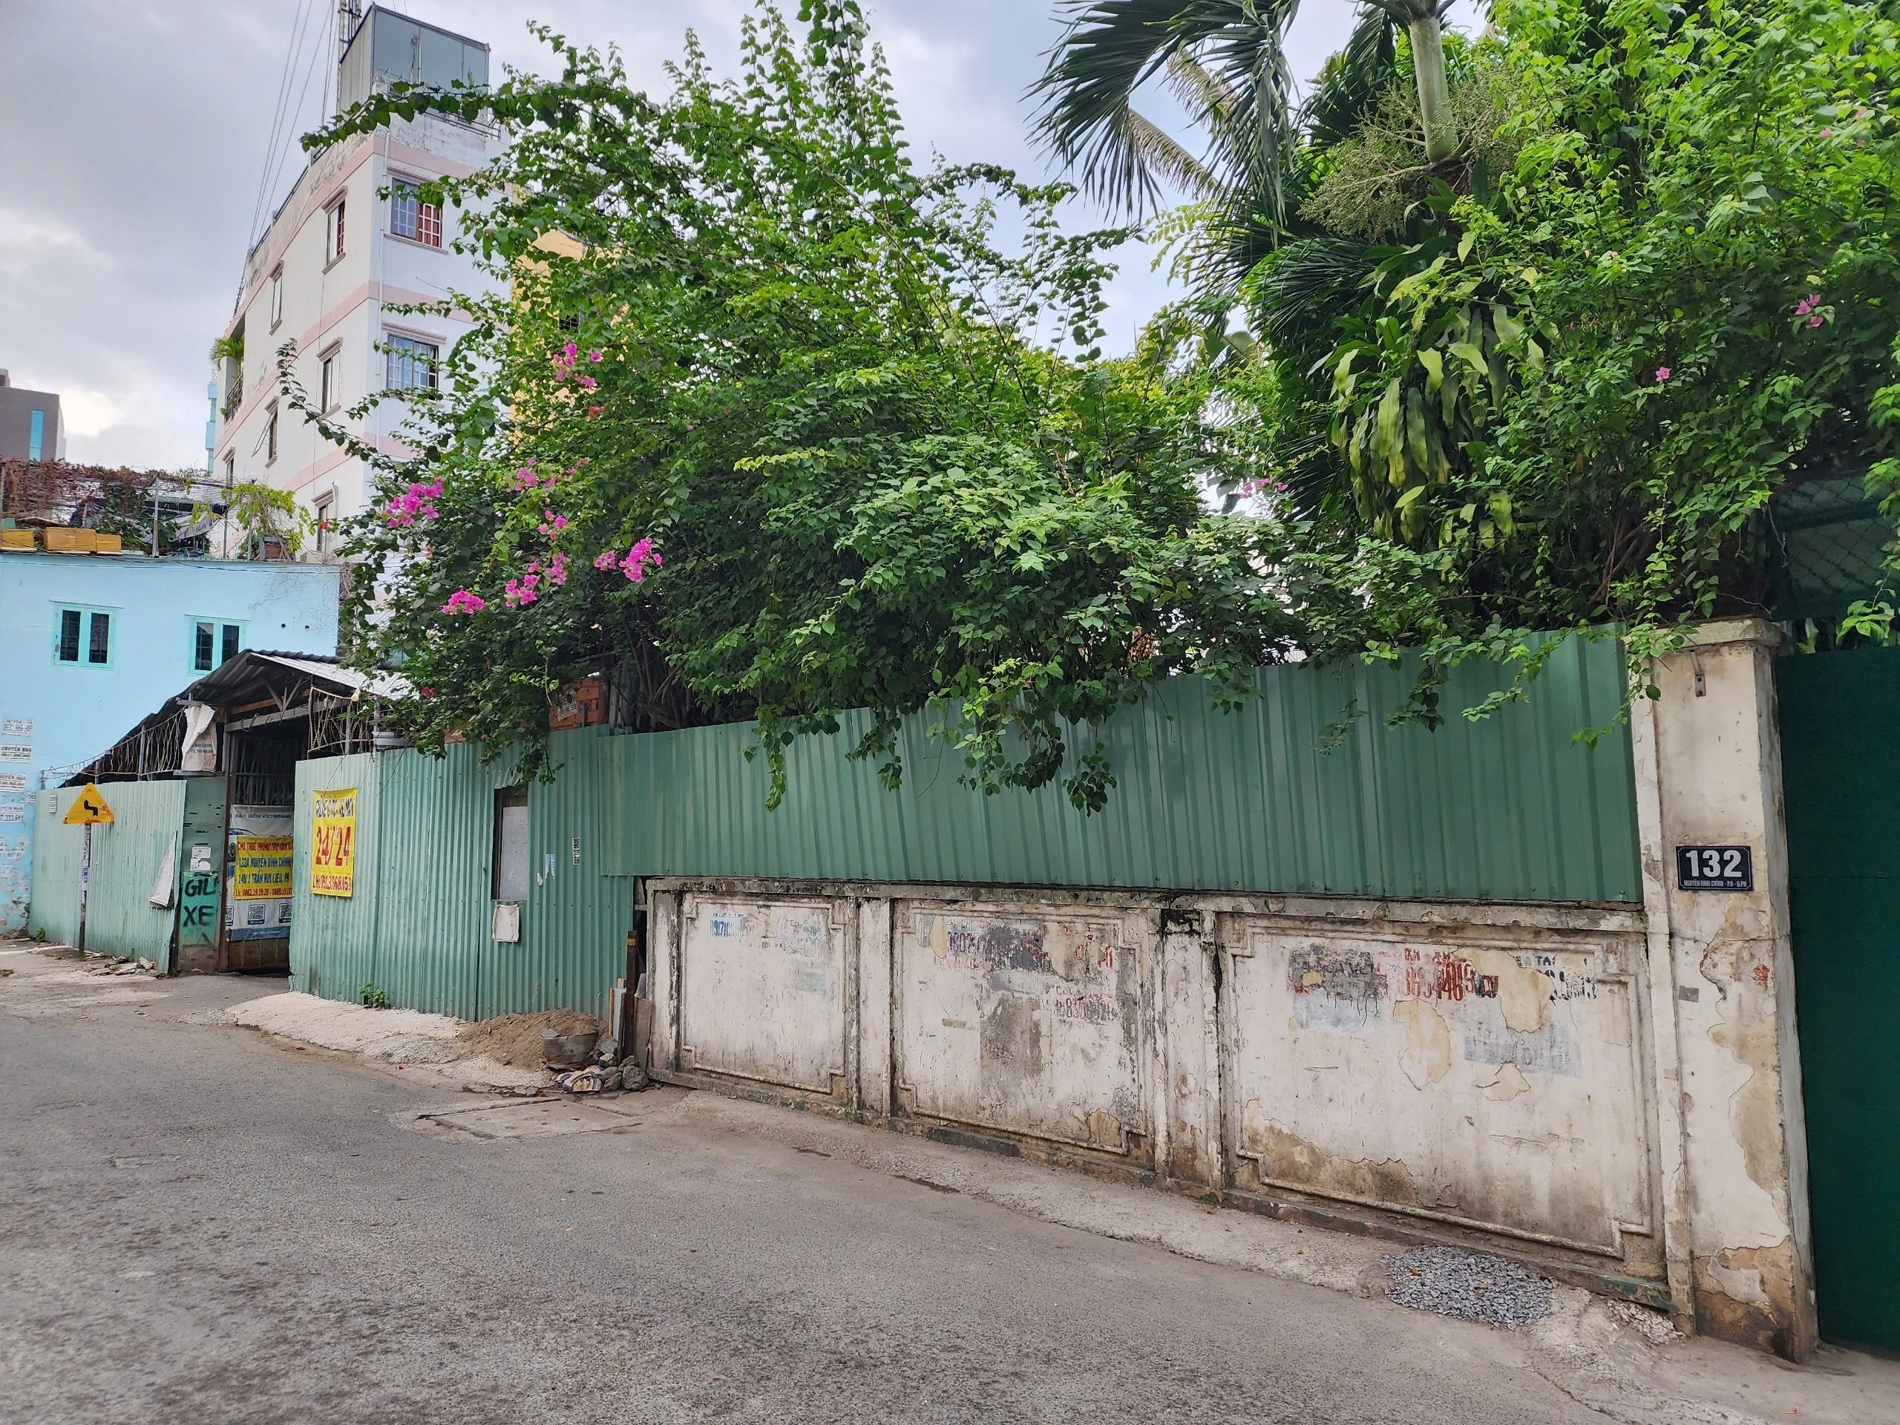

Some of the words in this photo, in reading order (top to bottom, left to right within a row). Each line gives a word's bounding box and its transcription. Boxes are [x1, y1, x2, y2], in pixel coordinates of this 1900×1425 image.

[315, 825, 352, 867] 24/24
[1685, 849, 1742, 877] 132
[183, 905, 214, 927] XE
